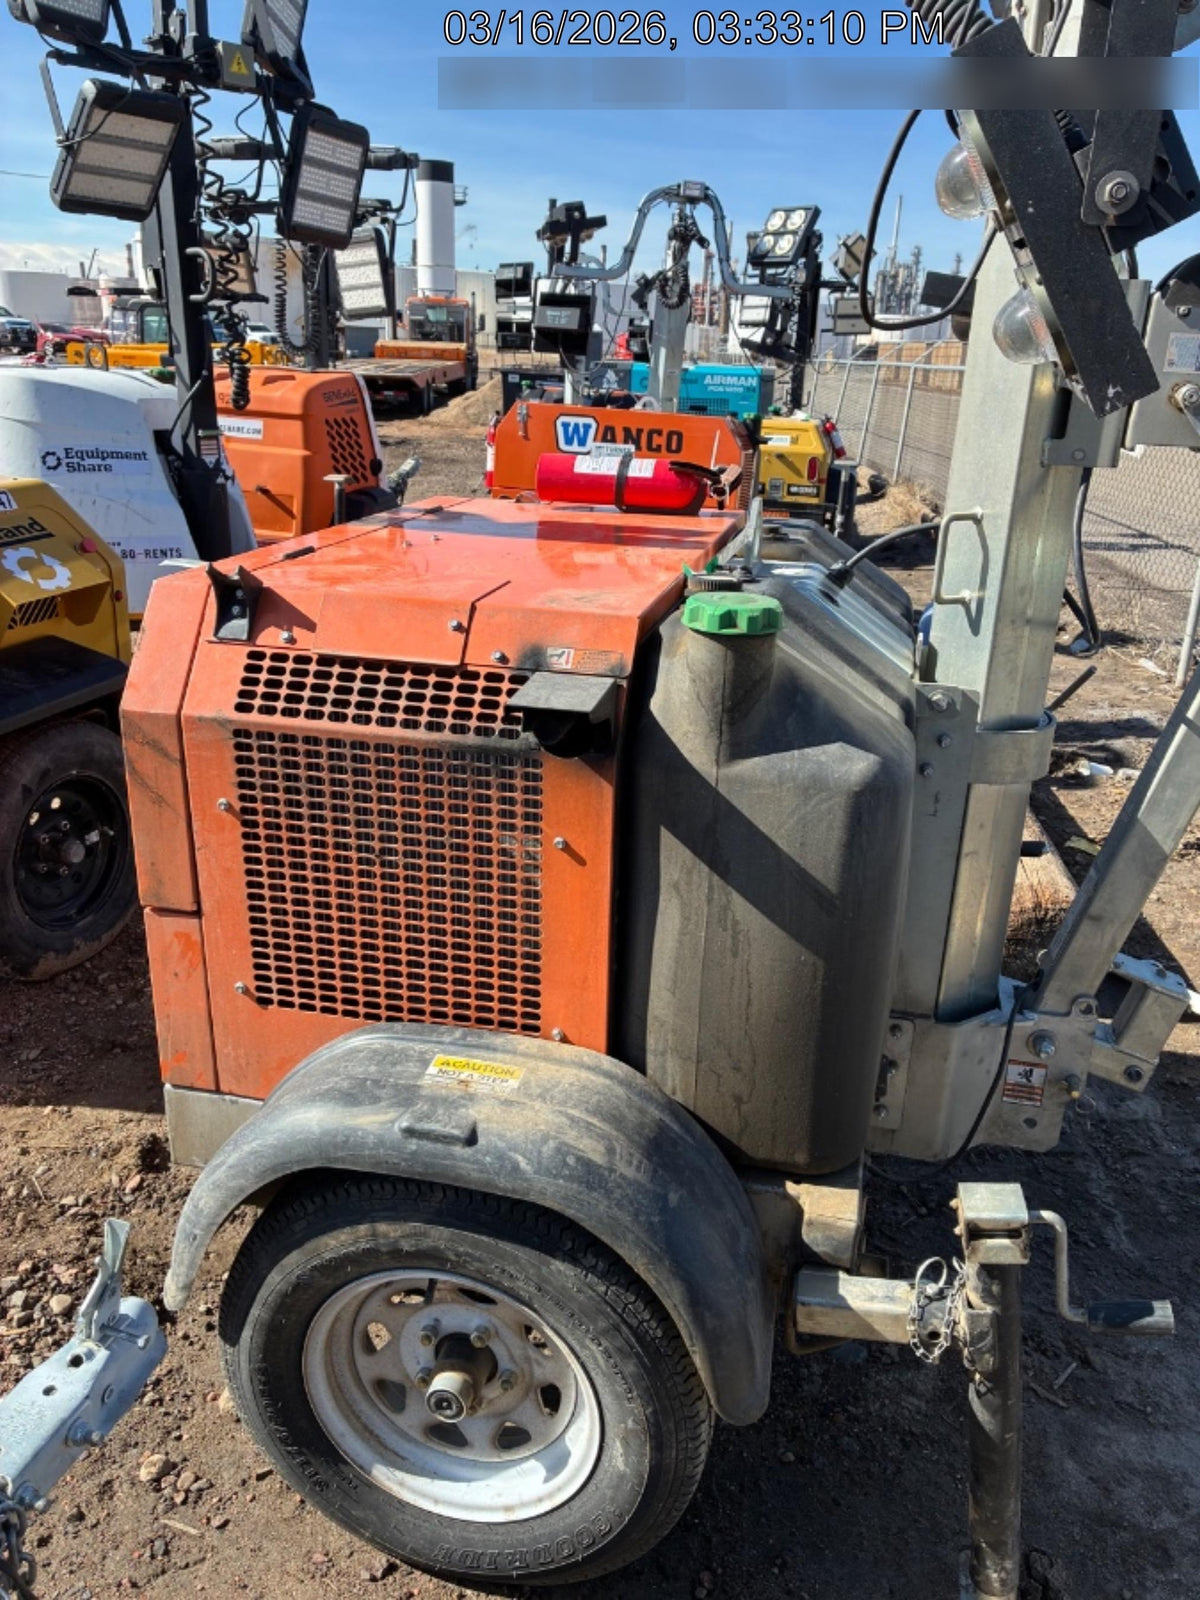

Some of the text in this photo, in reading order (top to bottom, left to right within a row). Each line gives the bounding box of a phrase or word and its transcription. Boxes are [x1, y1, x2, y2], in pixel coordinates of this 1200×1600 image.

[703, 374, 758, 387] AIRMAN
[558, 419, 684, 455] WANCO
[63, 447, 149, 462] Equipment
[65, 461, 113, 473] Share
[0, 516, 47, 539] and
[452, 1060, 516, 1076] CAUTION
